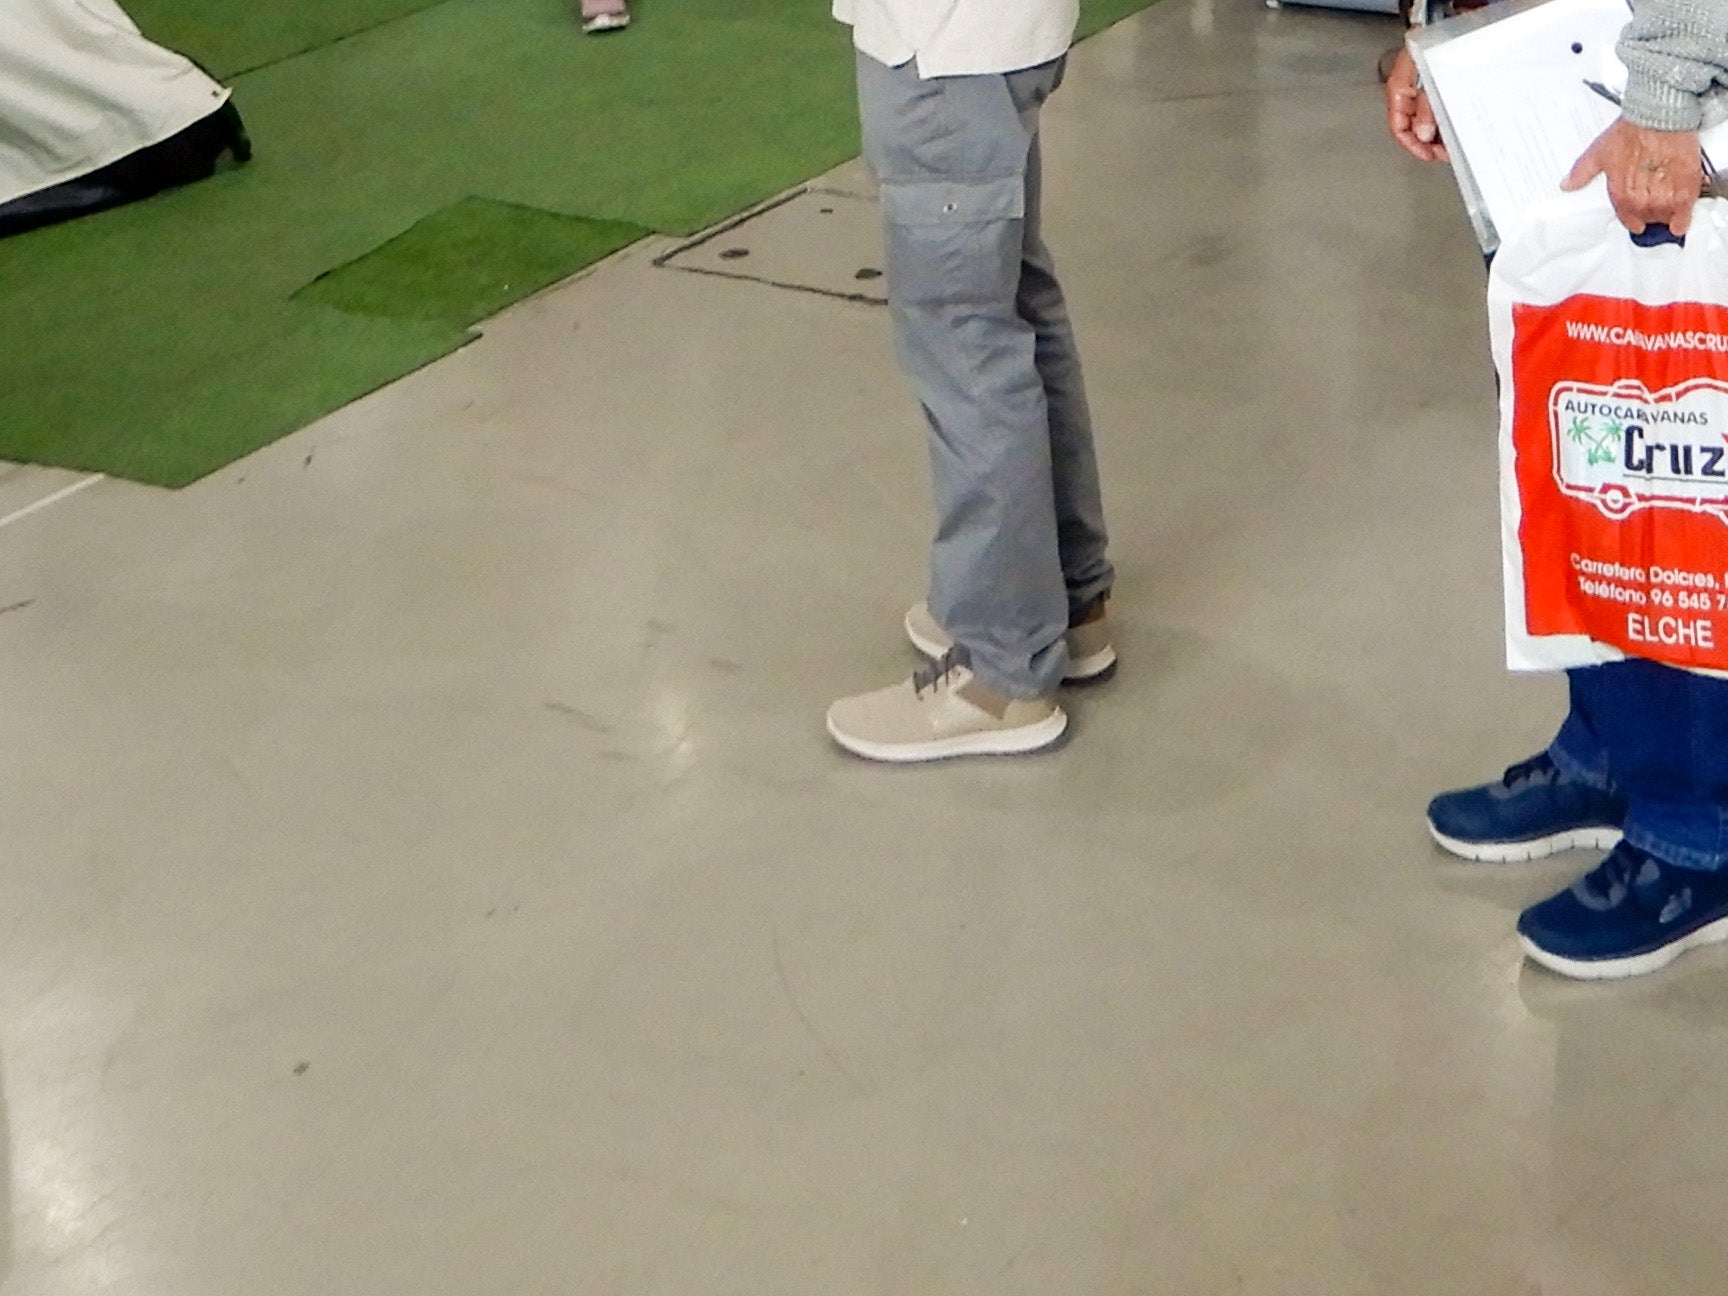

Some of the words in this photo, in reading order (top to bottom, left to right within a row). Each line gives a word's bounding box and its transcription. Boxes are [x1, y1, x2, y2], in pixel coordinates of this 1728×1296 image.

[1624, 425, 1727, 478] Cruz
[1570, 552, 1646, 582] Carretera
[1650, 588, 1673, 607] 96
[1627, 612, 1715, 649] ELCHE
